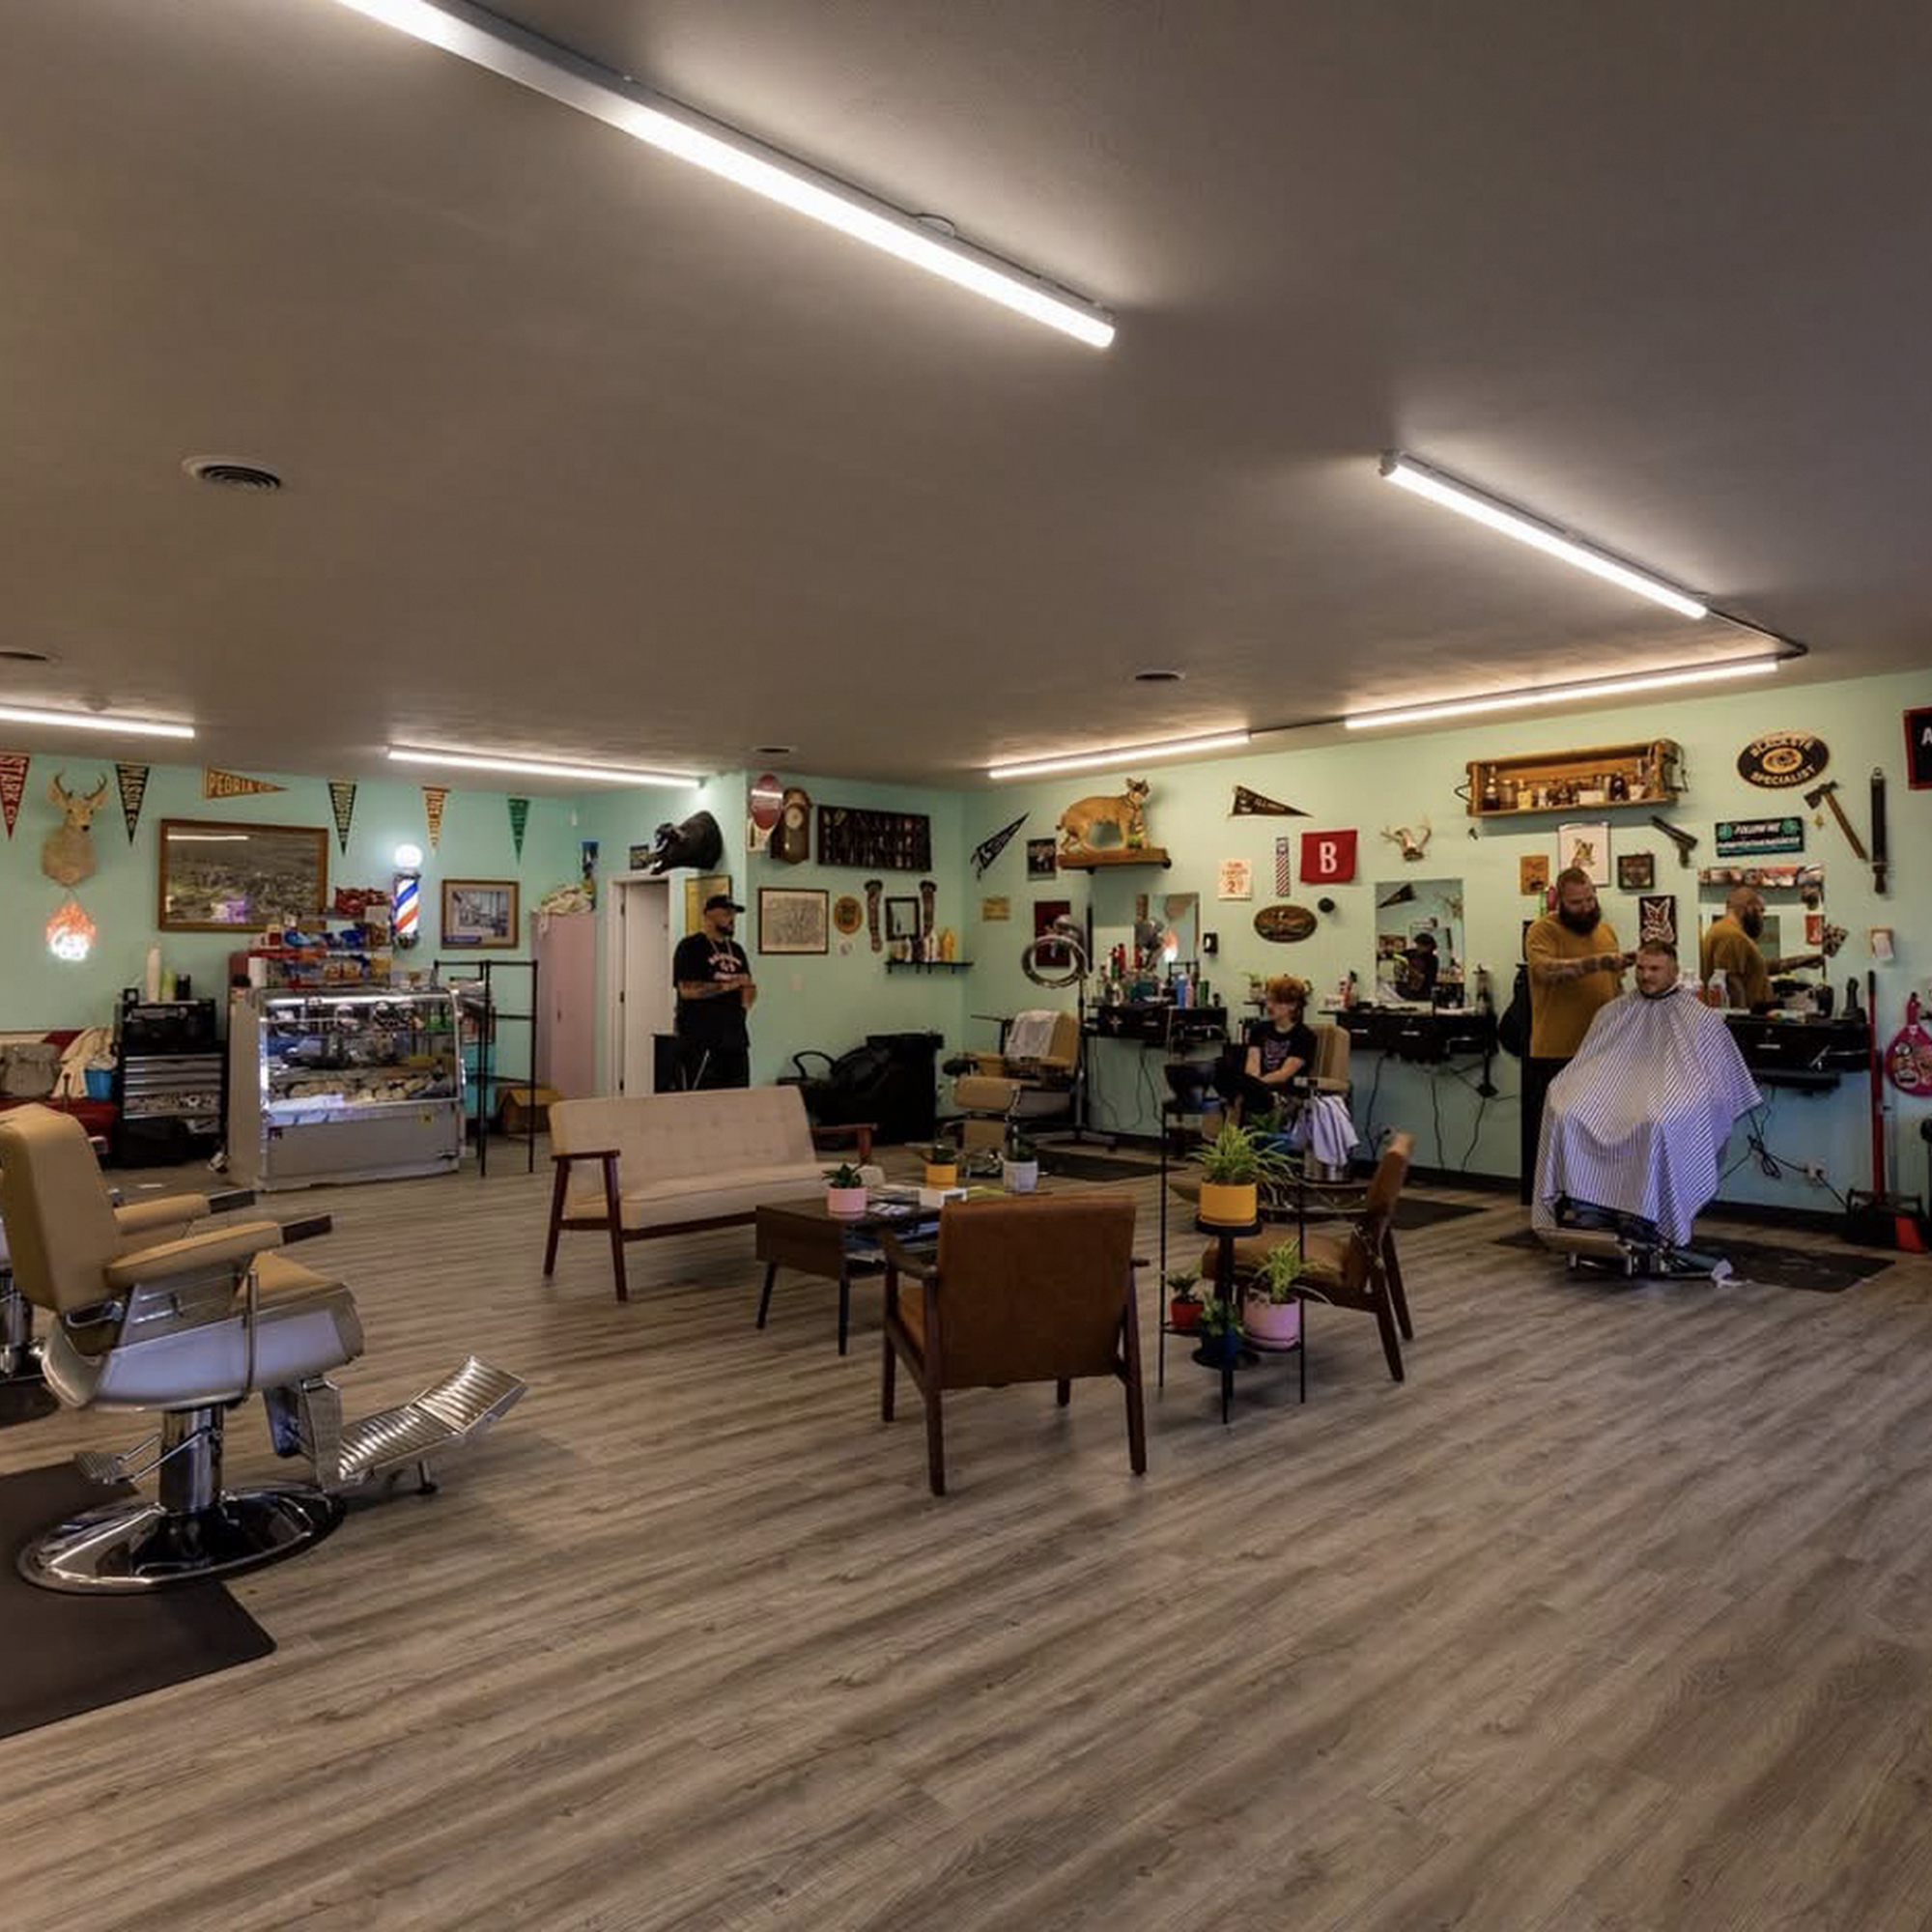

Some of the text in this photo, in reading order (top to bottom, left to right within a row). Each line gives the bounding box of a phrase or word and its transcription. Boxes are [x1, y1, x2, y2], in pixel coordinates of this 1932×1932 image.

[0, 757, 27, 802] STARK
[119, 766, 146, 810] MASON
[209, 773, 254, 796] PEORIA
[1749, 763, 1816, 785] SPECIALIST
[1320, 841, 1338, 874] B
